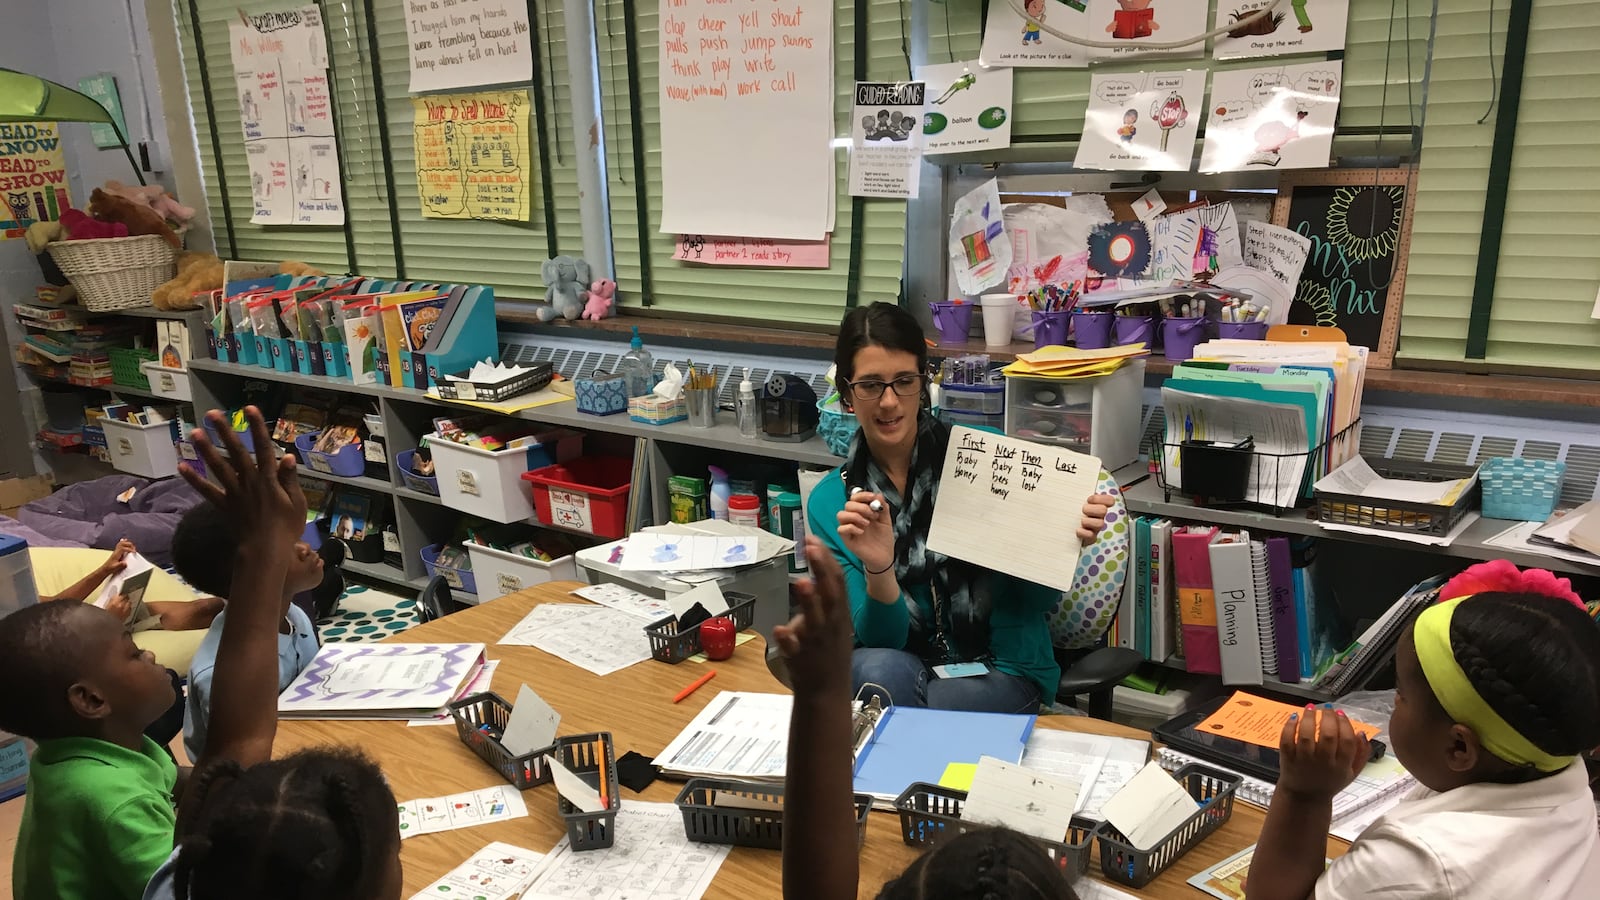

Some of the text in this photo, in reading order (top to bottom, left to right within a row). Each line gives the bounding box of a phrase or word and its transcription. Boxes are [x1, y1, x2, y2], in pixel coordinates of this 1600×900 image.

[411, 20, 418, 34] I
[421, 16, 448, 34] hugged
[450, 13, 466, 26] him
[470, 14, 480, 26] my
[665, 6, 803, 37] clap cheer yell shout
[414, 21, 528, 51] were trembling because the
[666, 37, 689, 59] pulls
[700, 35, 729, 56] push
[741, 36, 776, 55] jump
[414, 56, 435, 71] lamp
[439, 52, 464, 67] almost
[468, 48, 481, 62] fell
[485, 48, 495, 57] on
[672, 53, 777, 81] think play write
[666, 85, 691, 102] wave
[737, 80, 761, 96] work
[771, 72, 796, 92] call
[858, 86, 923, 105] GUIDED READING
[461, 99, 479, 120] Spell
[480, 98, 507, 119] Words
[1160, 107, 1181, 121] STOP
[0, 124, 38, 140] EAD
[0, 158, 37, 173] EAD
[714, 238, 737, 249] partner
[715, 248, 791, 263] partner 2 reads story
[1330, 277, 1380, 315] Nix
[325, 351, 332, 361] 12
[376, 360, 383, 369] 16
[402, 361, 410, 372] 18
[415, 363, 422, 373] 19
[430, 368, 437, 378] 20
[956, 452, 978, 467] Baby
[962, 434, 1077, 472] First Next Then Last
[992, 459, 1014, 474] Baby
[992, 472, 1009, 486] bees
[1021, 467, 1042, 482] Baby
[1021, 479, 1037, 492] lost
[1274, 586, 1289, 615] Sorts
[1222, 590, 1245, 646] Planning
